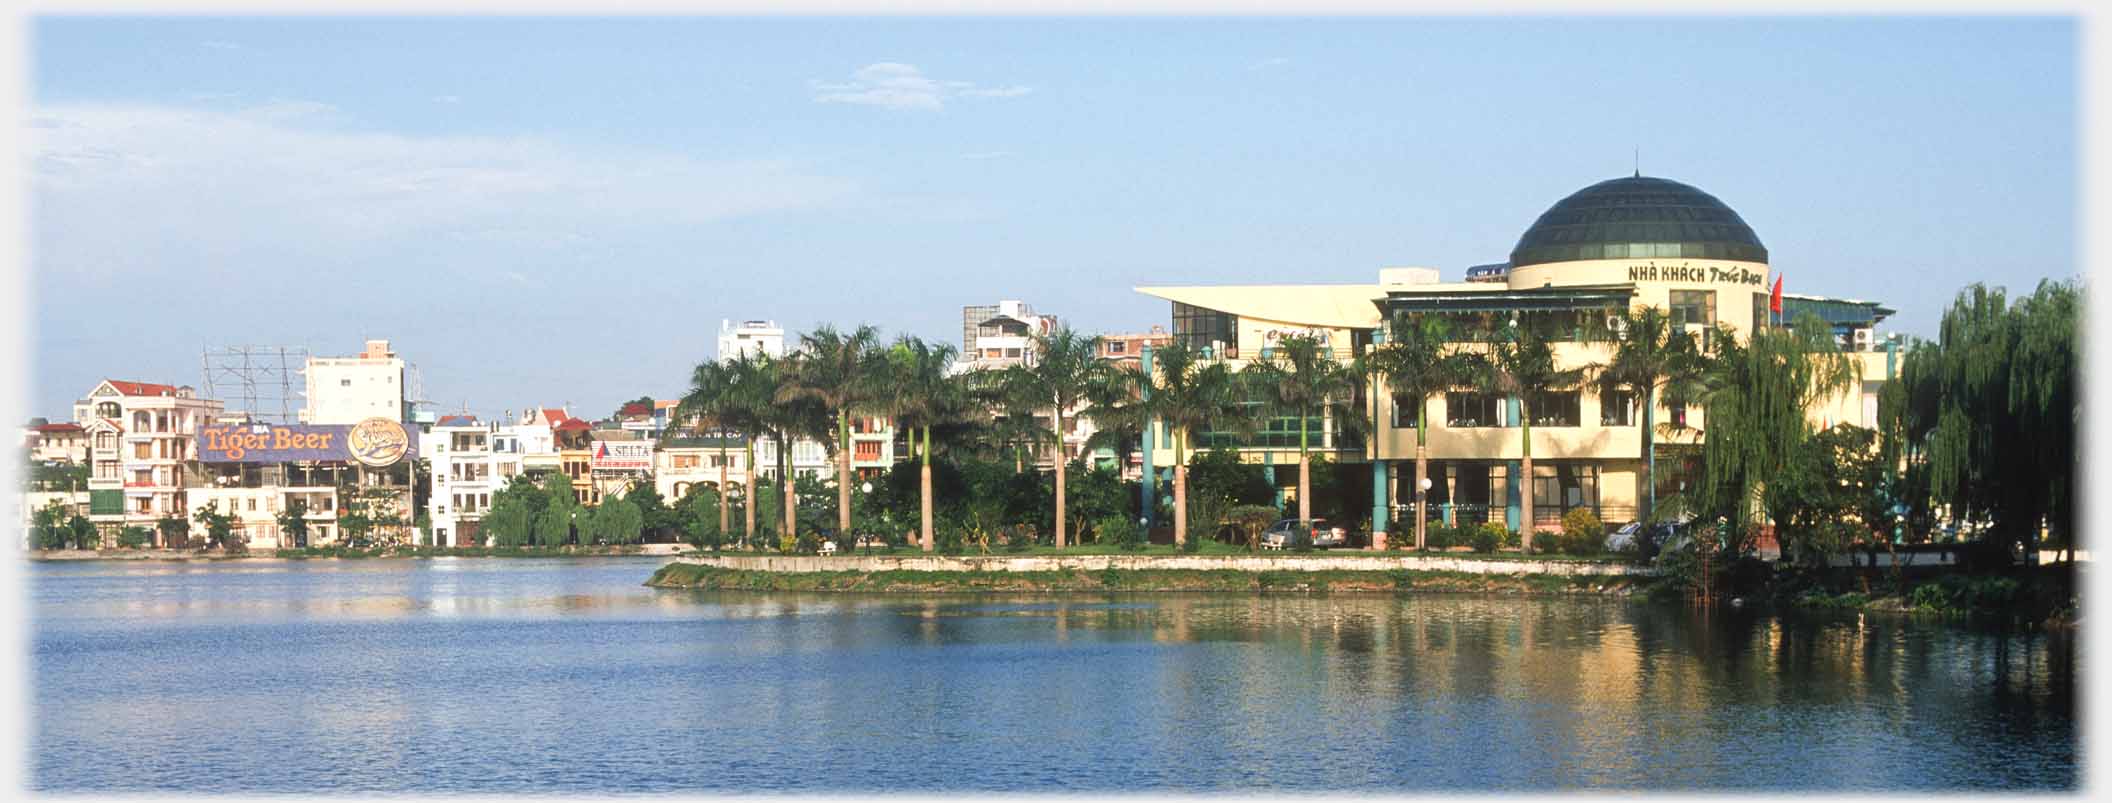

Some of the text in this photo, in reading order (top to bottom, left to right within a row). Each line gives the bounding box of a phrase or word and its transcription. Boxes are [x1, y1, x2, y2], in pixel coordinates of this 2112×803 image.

[1629, 261, 1657, 281] NHÀ
[1662, 262, 1705, 282] KHÁCH
[253, 424, 270, 434] BIA
[204, 427, 271, 460] Tiger
[272, 427, 334, 450] Beer
